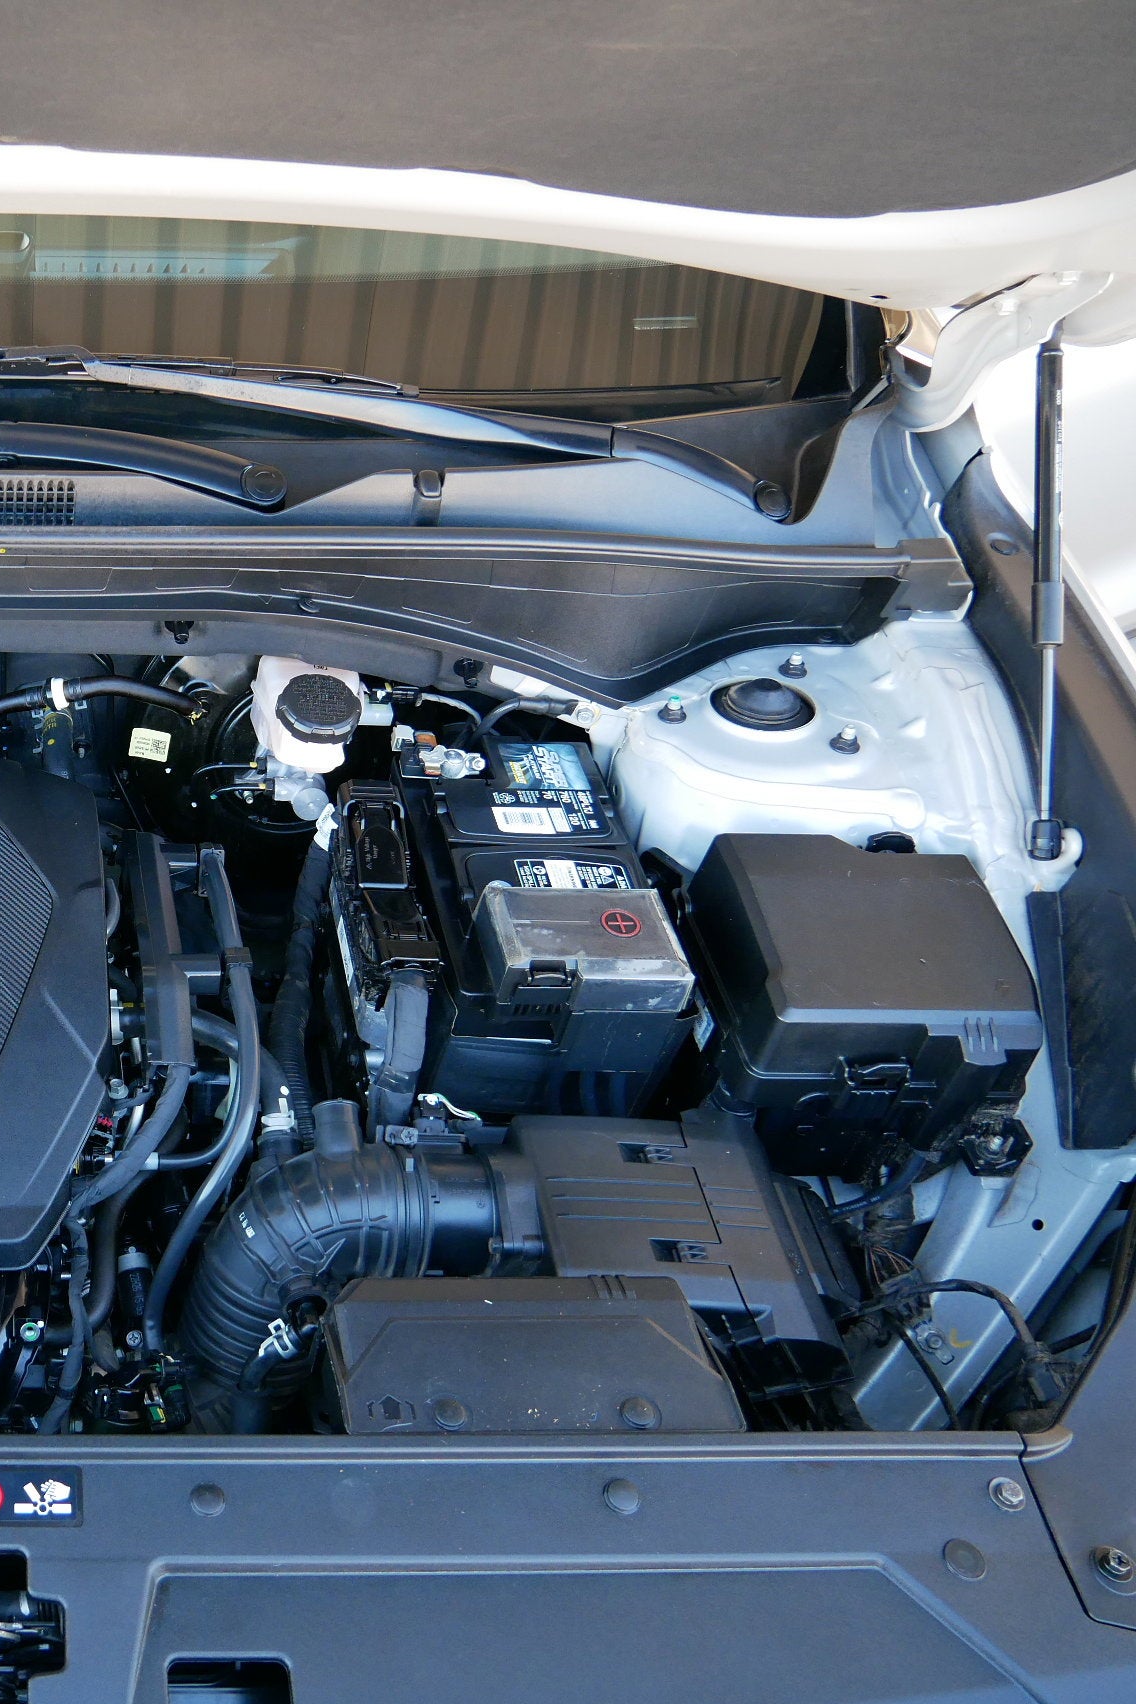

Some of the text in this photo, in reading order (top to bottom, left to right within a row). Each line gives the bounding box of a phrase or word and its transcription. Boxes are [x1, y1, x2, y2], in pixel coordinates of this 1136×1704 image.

[532, 745, 555, 785] START
[541, 790, 552, 800] 70
[567, 812, 581, 826] 120
